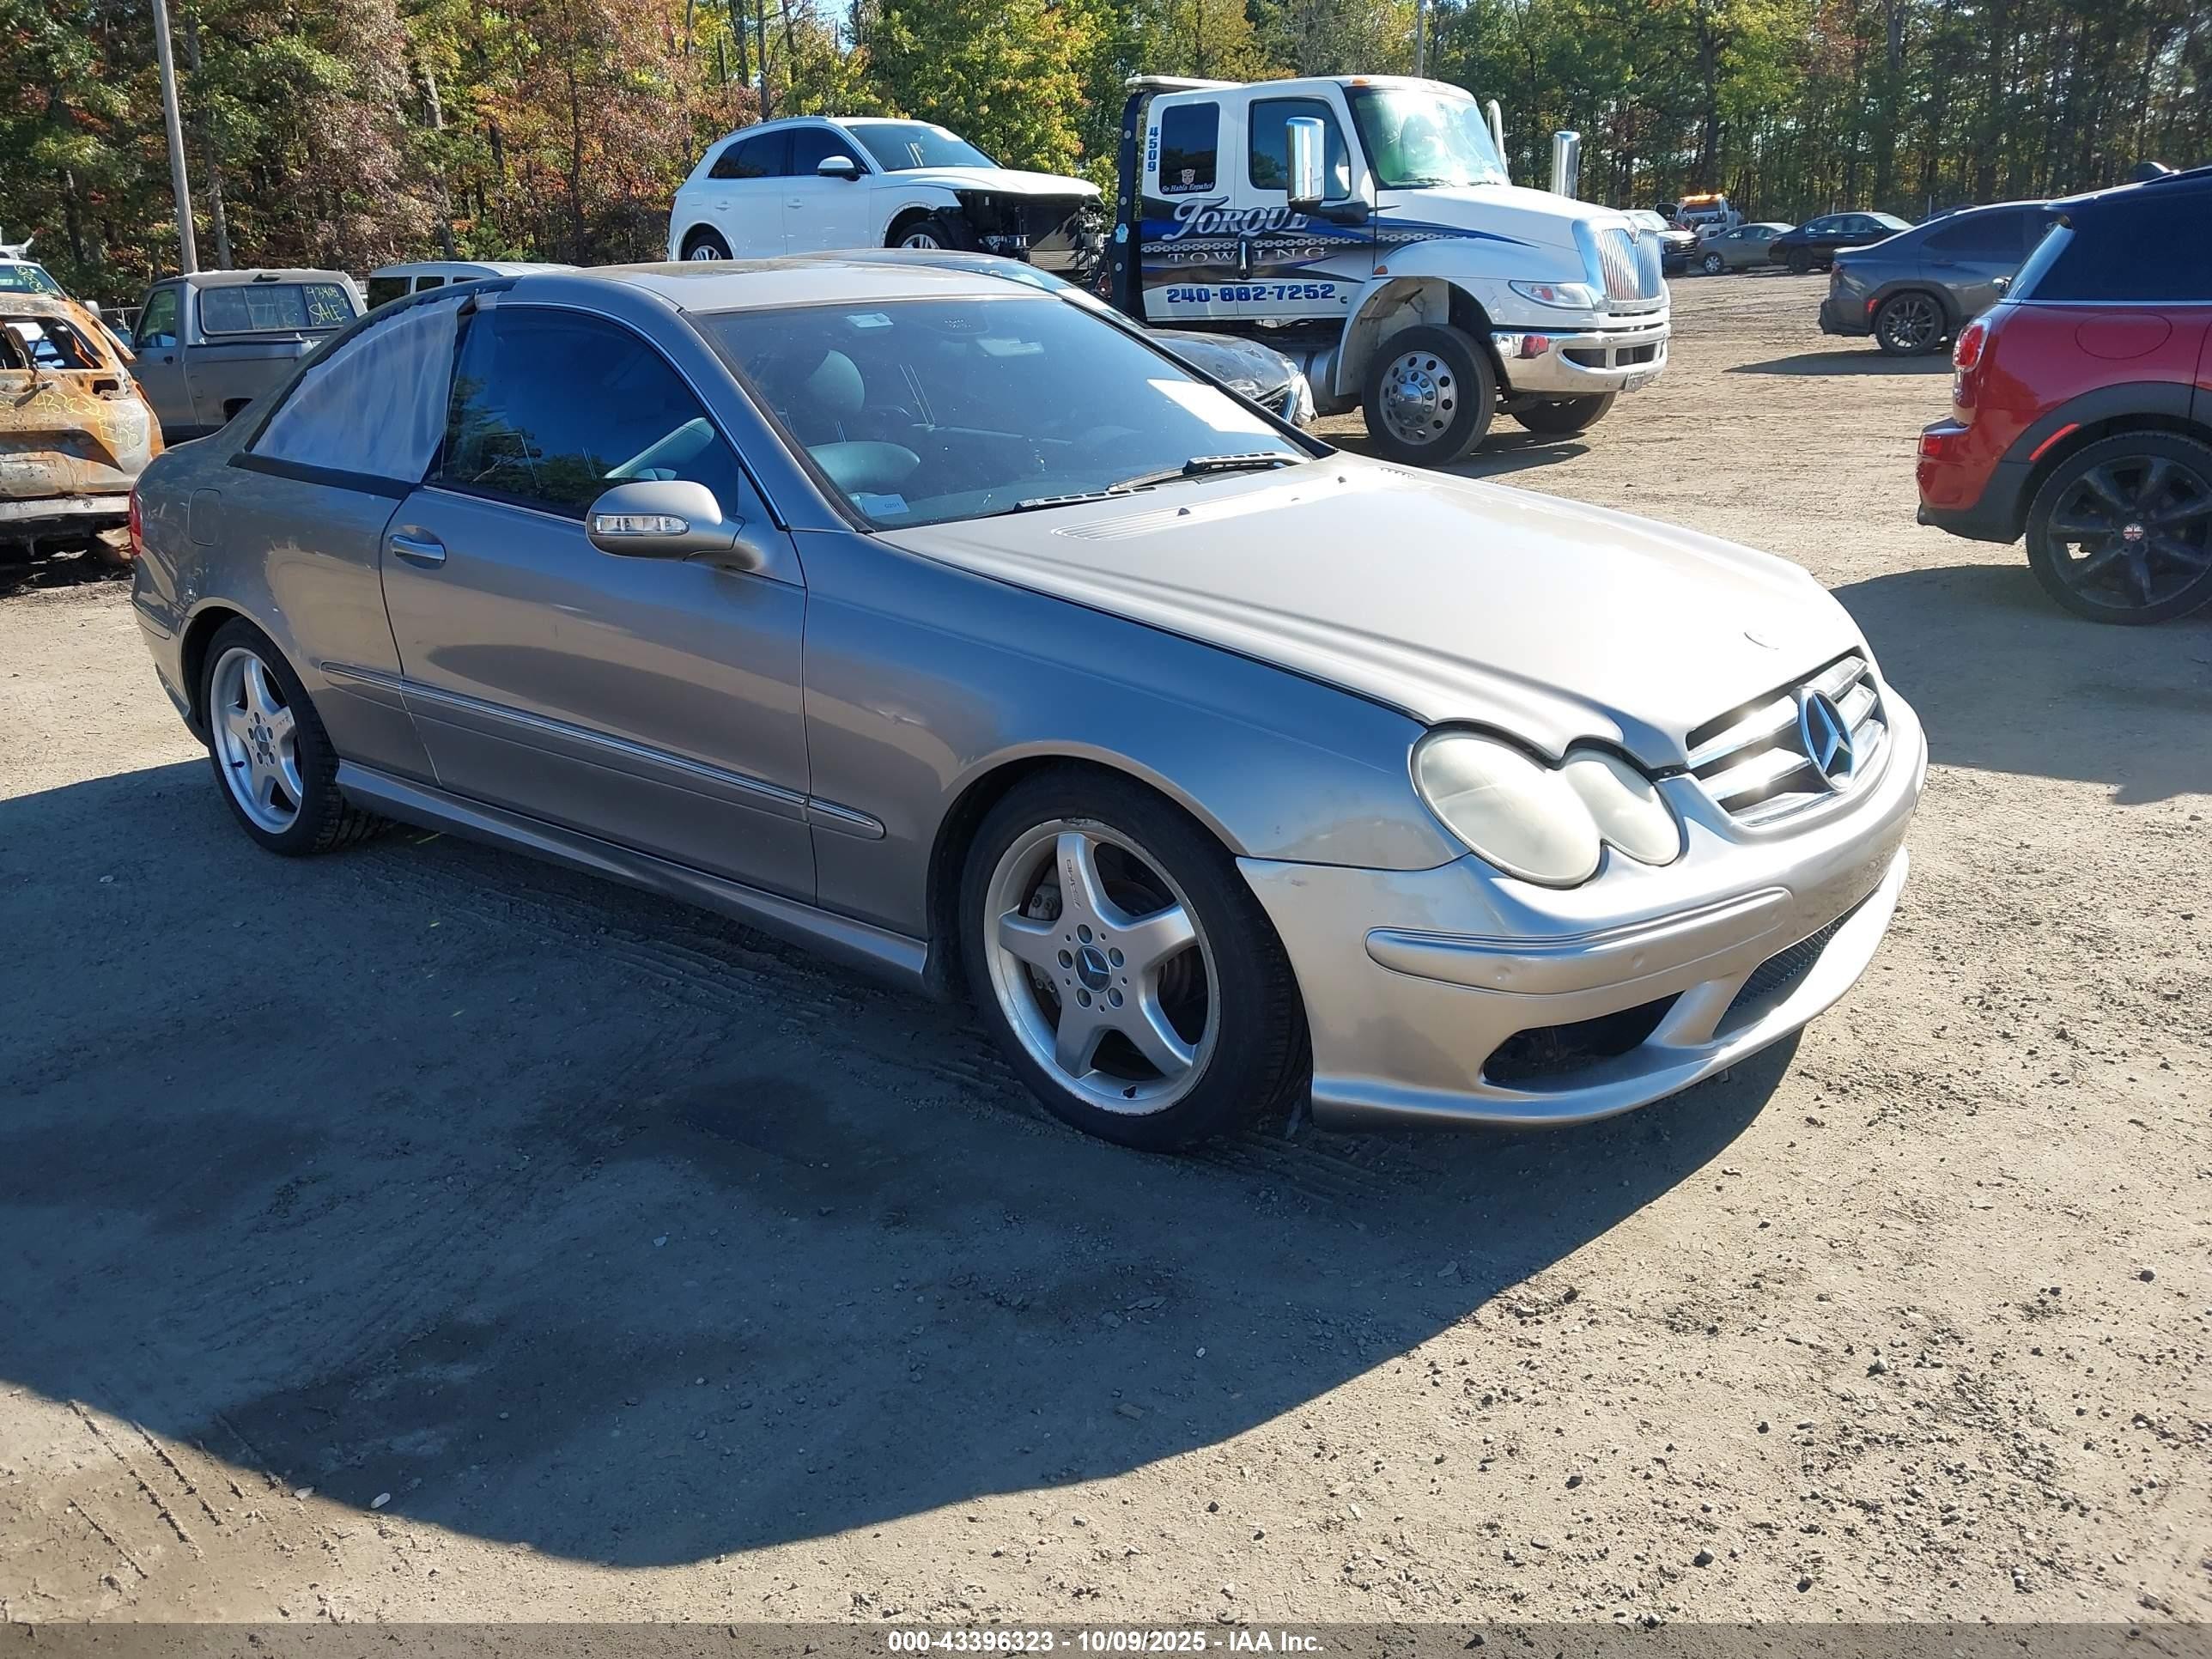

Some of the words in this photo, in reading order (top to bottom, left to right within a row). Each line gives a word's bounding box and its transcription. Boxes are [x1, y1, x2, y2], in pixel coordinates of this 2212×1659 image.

[1147, 127, 1158, 172] 4509
[1189, 181, 1214, 191] Español
[1161, 196, 1310, 241] TORQUE
[1168, 246, 1329, 264] TOWING
[308, 301, 347, 325] SALE
